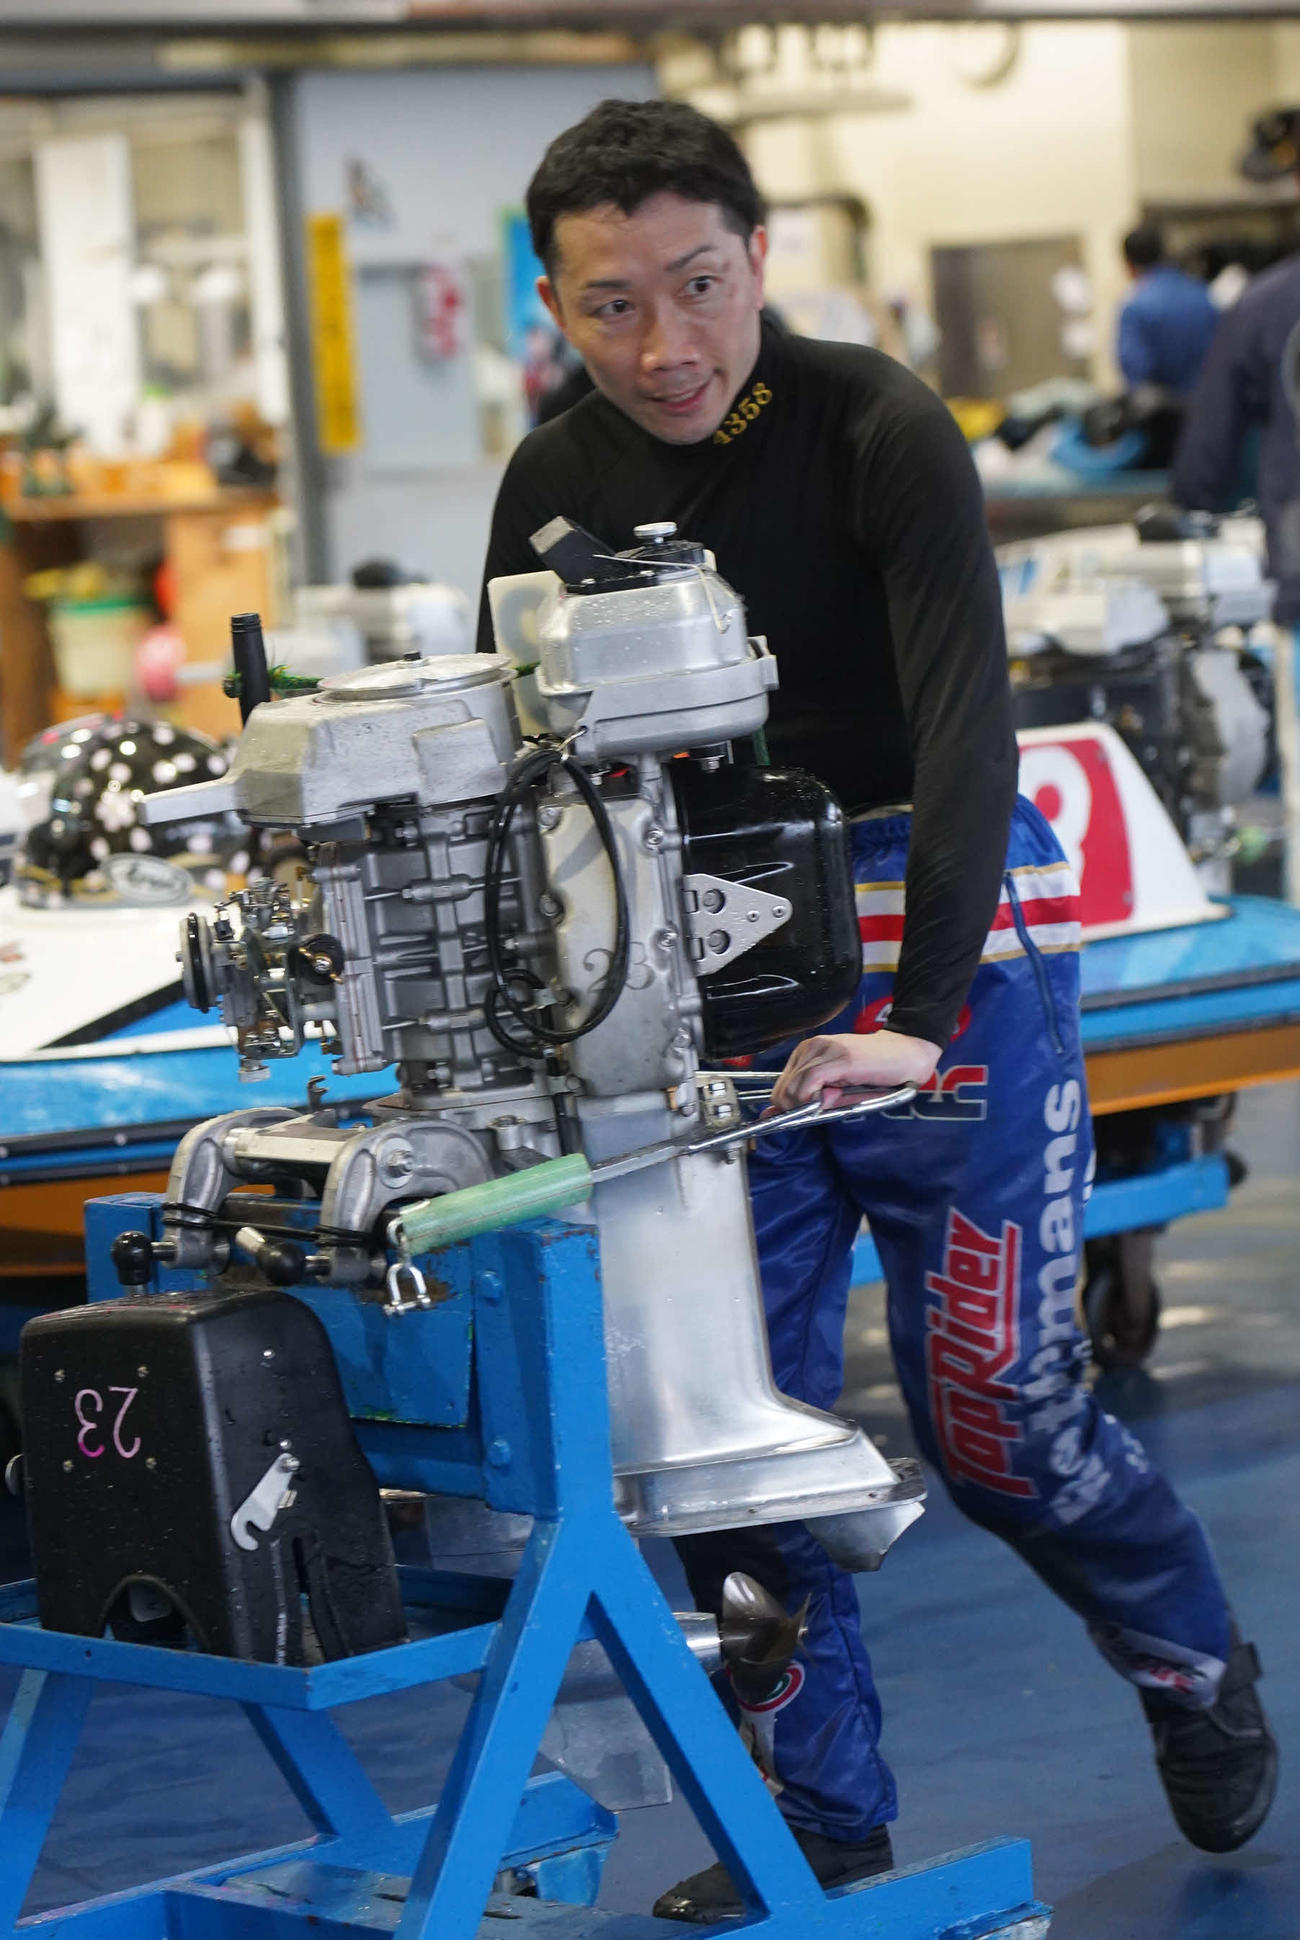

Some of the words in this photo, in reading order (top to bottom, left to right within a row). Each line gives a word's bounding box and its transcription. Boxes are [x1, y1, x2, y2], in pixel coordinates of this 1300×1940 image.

[713, 382, 773, 444] 4358
[924, 1205, 1041, 1499] TopRider
[1022, 1079, 1112, 1525] Rothmans
[74, 1386, 141, 1458] 23
